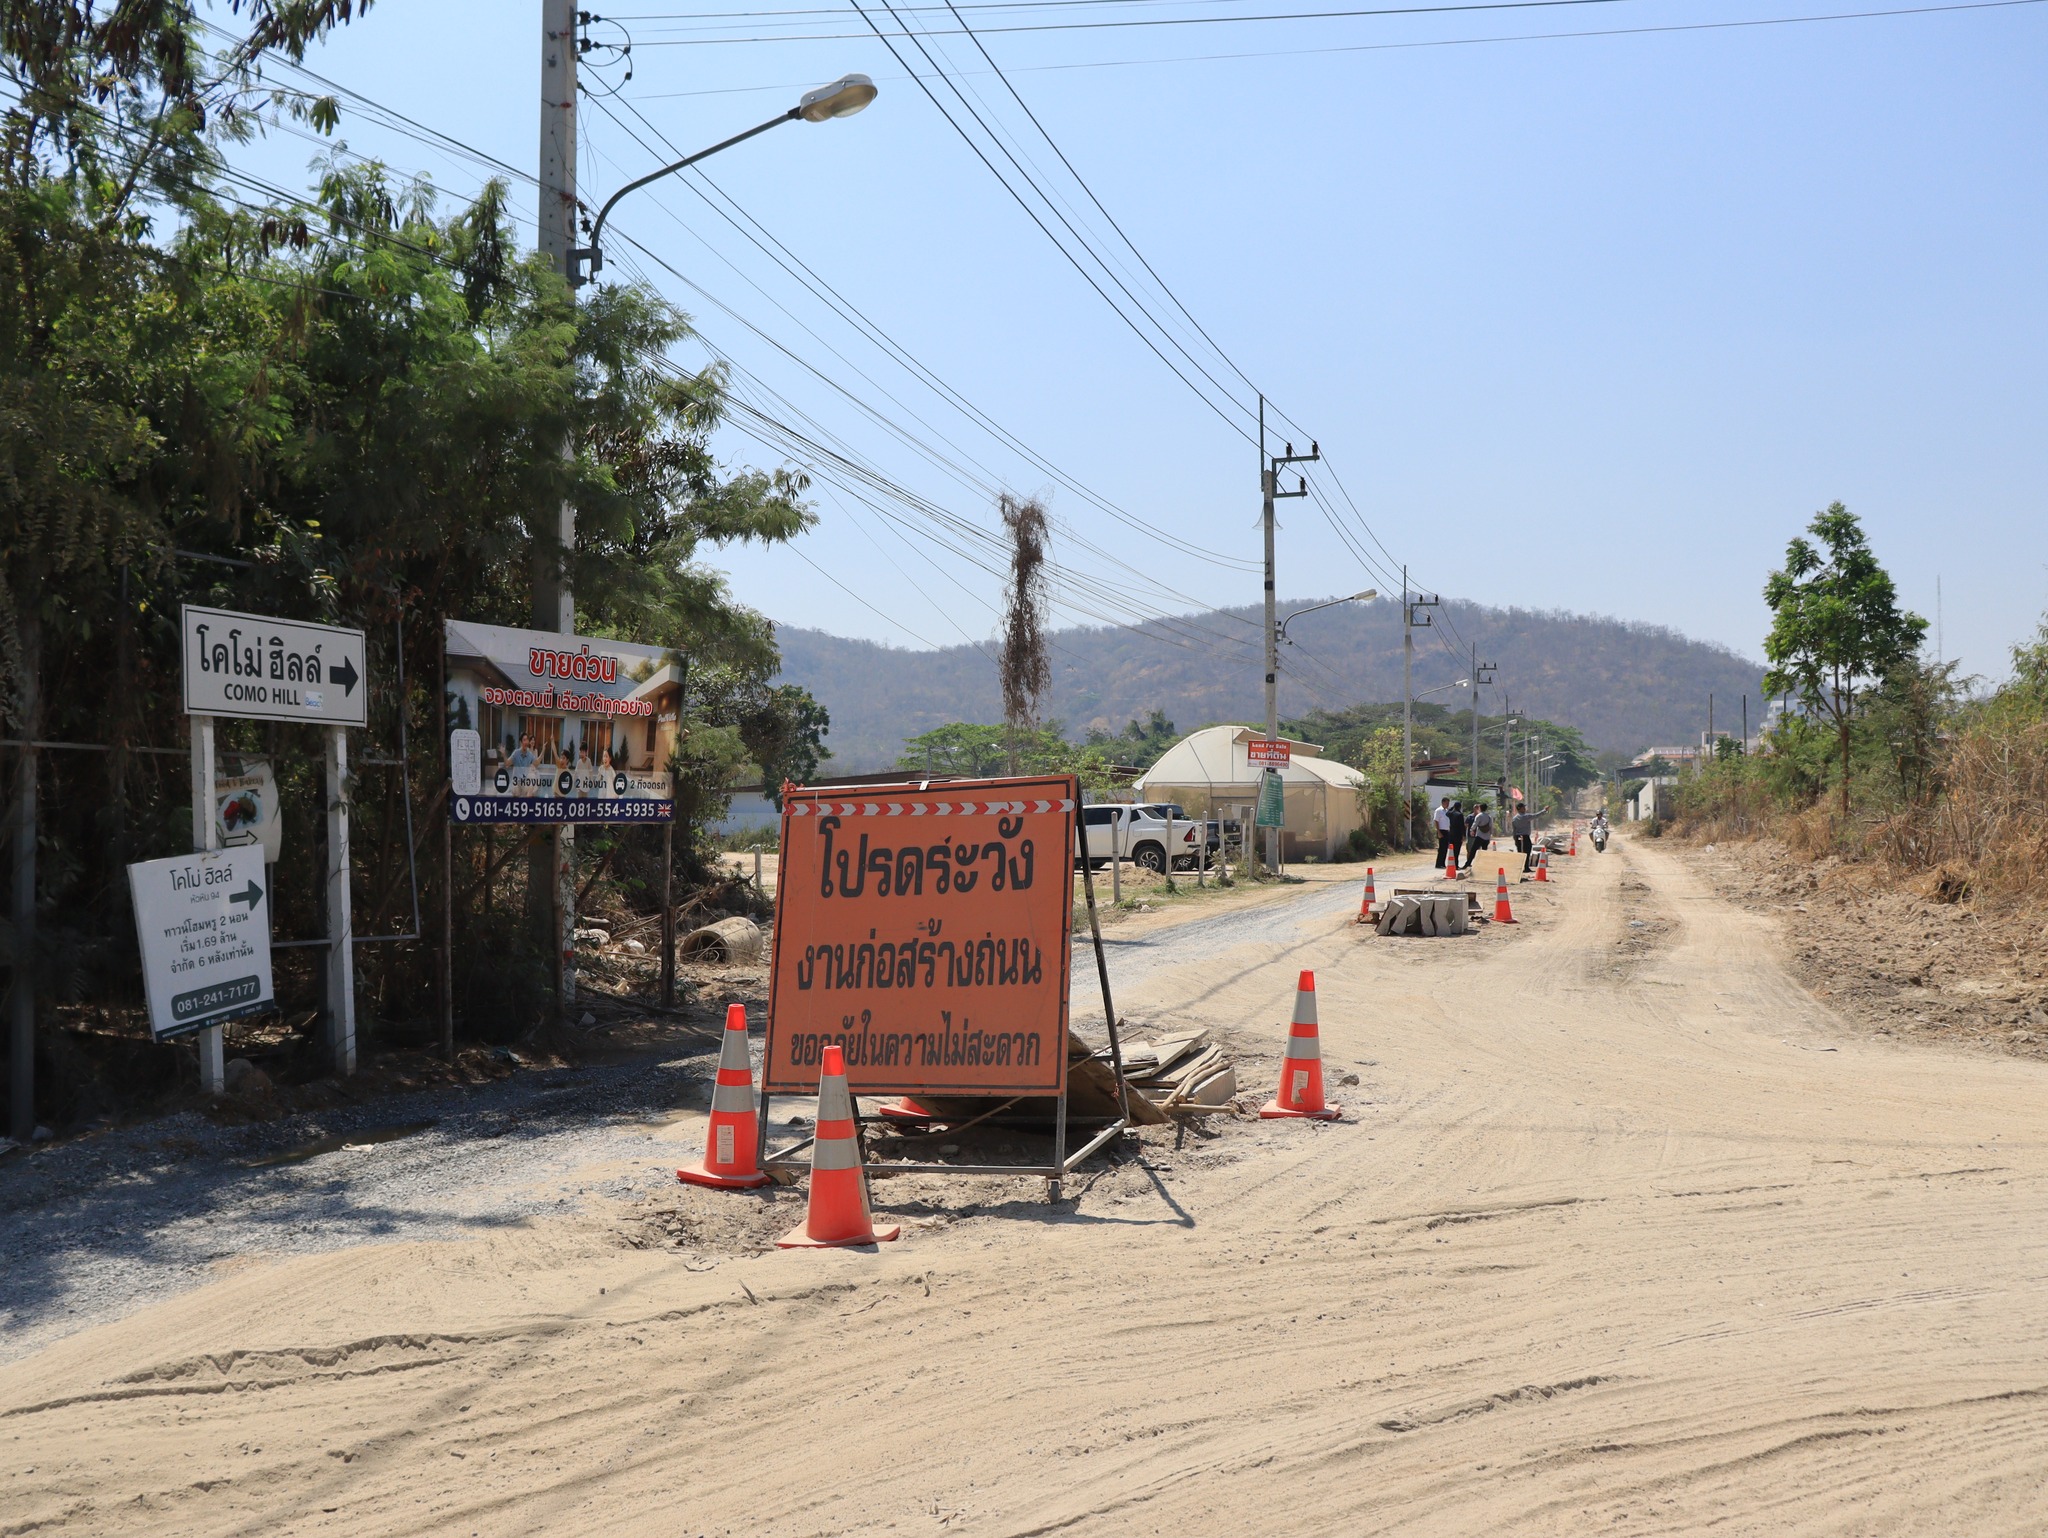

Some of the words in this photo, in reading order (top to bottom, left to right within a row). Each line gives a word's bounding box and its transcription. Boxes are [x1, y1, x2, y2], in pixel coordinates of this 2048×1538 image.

[196, 623, 262, 678] โคโม่
[269, 636, 322, 684] ฮิลล์
[529, 644, 617, 684] ขายด่วน
[224, 683, 267, 703] COMO
[272, 687, 301, 706] HILL
[485, 683, 555, 709] จองตอนนี้
[556, 690, 653, 720] เลือกได้ทุกอย่าง
[512, 778, 519, 787] 3
[520, 774, 552, 787] ห้องนอน
[575, 779, 581, 787] 2
[630, 780, 635, 788] 2
[170, 867, 201, 891] โคโม่
[205, 863, 233, 886] ฮิลล์
[219, 916, 226, 926] 2
[229, 912, 249, 924] นอน
[219, 930, 237, 944] ล้าน
[170, 958, 195, 974] จำกัด
[198, 956, 205, 967] 6
[208, 940, 254, 965] หลังเท่านั้น
[177, 982, 256, 1013] 081-241-7177
